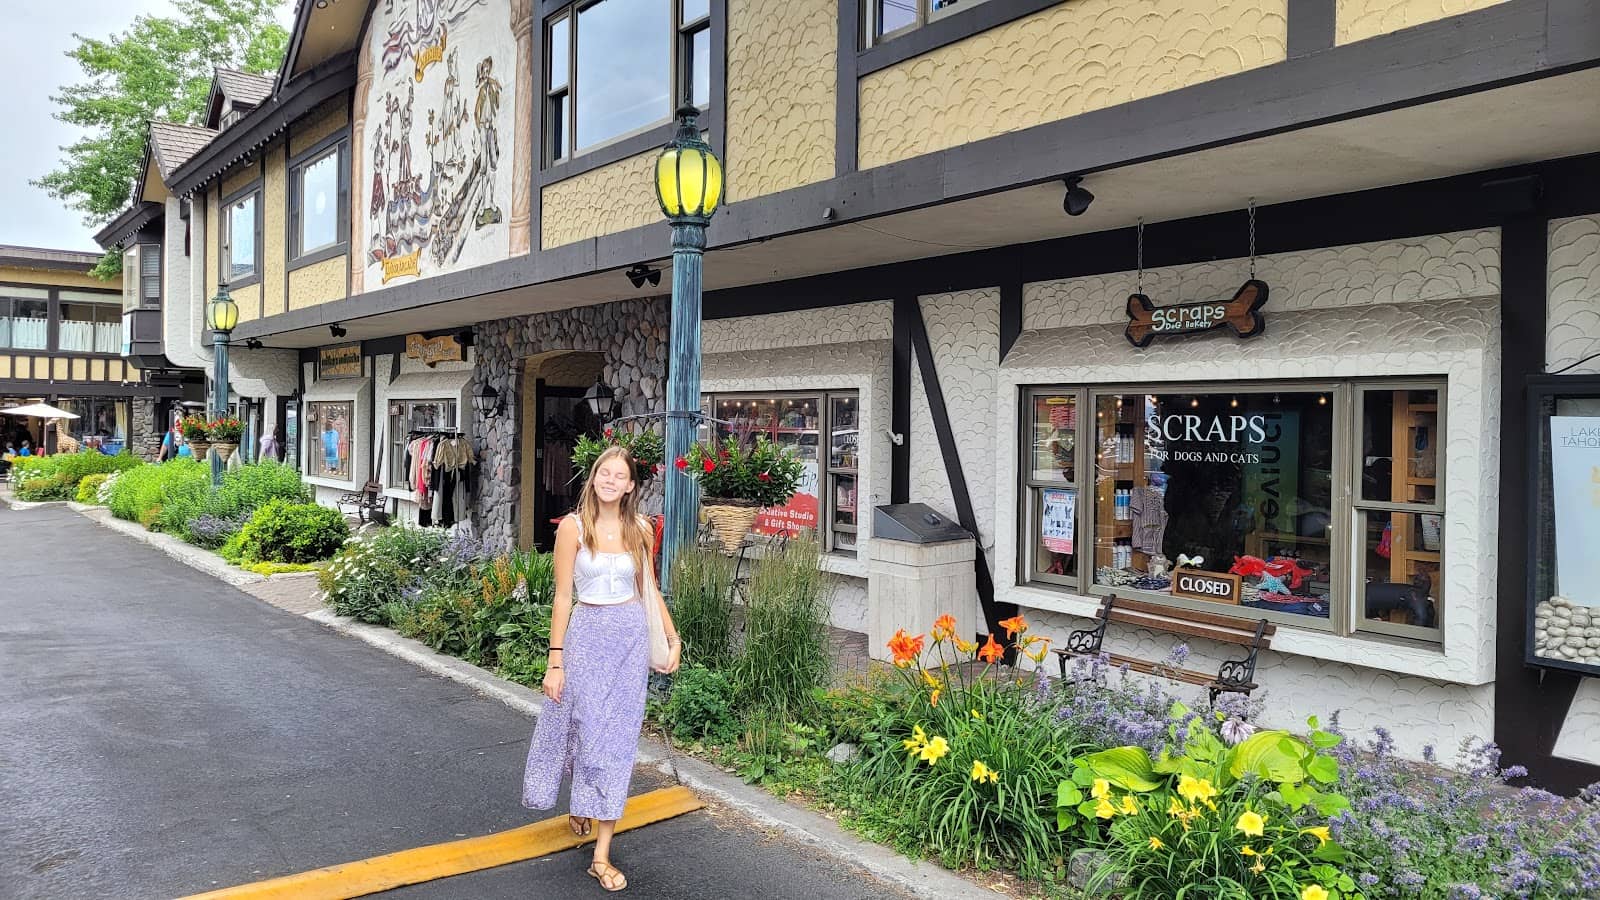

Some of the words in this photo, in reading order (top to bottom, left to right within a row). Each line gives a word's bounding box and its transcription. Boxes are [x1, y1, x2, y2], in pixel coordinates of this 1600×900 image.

[1151, 304, 1226, 332] Scraps
[1147, 414, 1266, 444] SCRAPS
[1149, 451, 1170, 463] FOR
[1173, 451, 1203, 462] DOGS
[1204, 452, 1228, 464] AND
[1230, 453, 1260, 465] CATS
[789, 508, 814, 521] Studio
[764, 518, 769, 527] &
[770, 518, 785, 529] Gift
[1179, 576, 1232, 596] CLOSED
